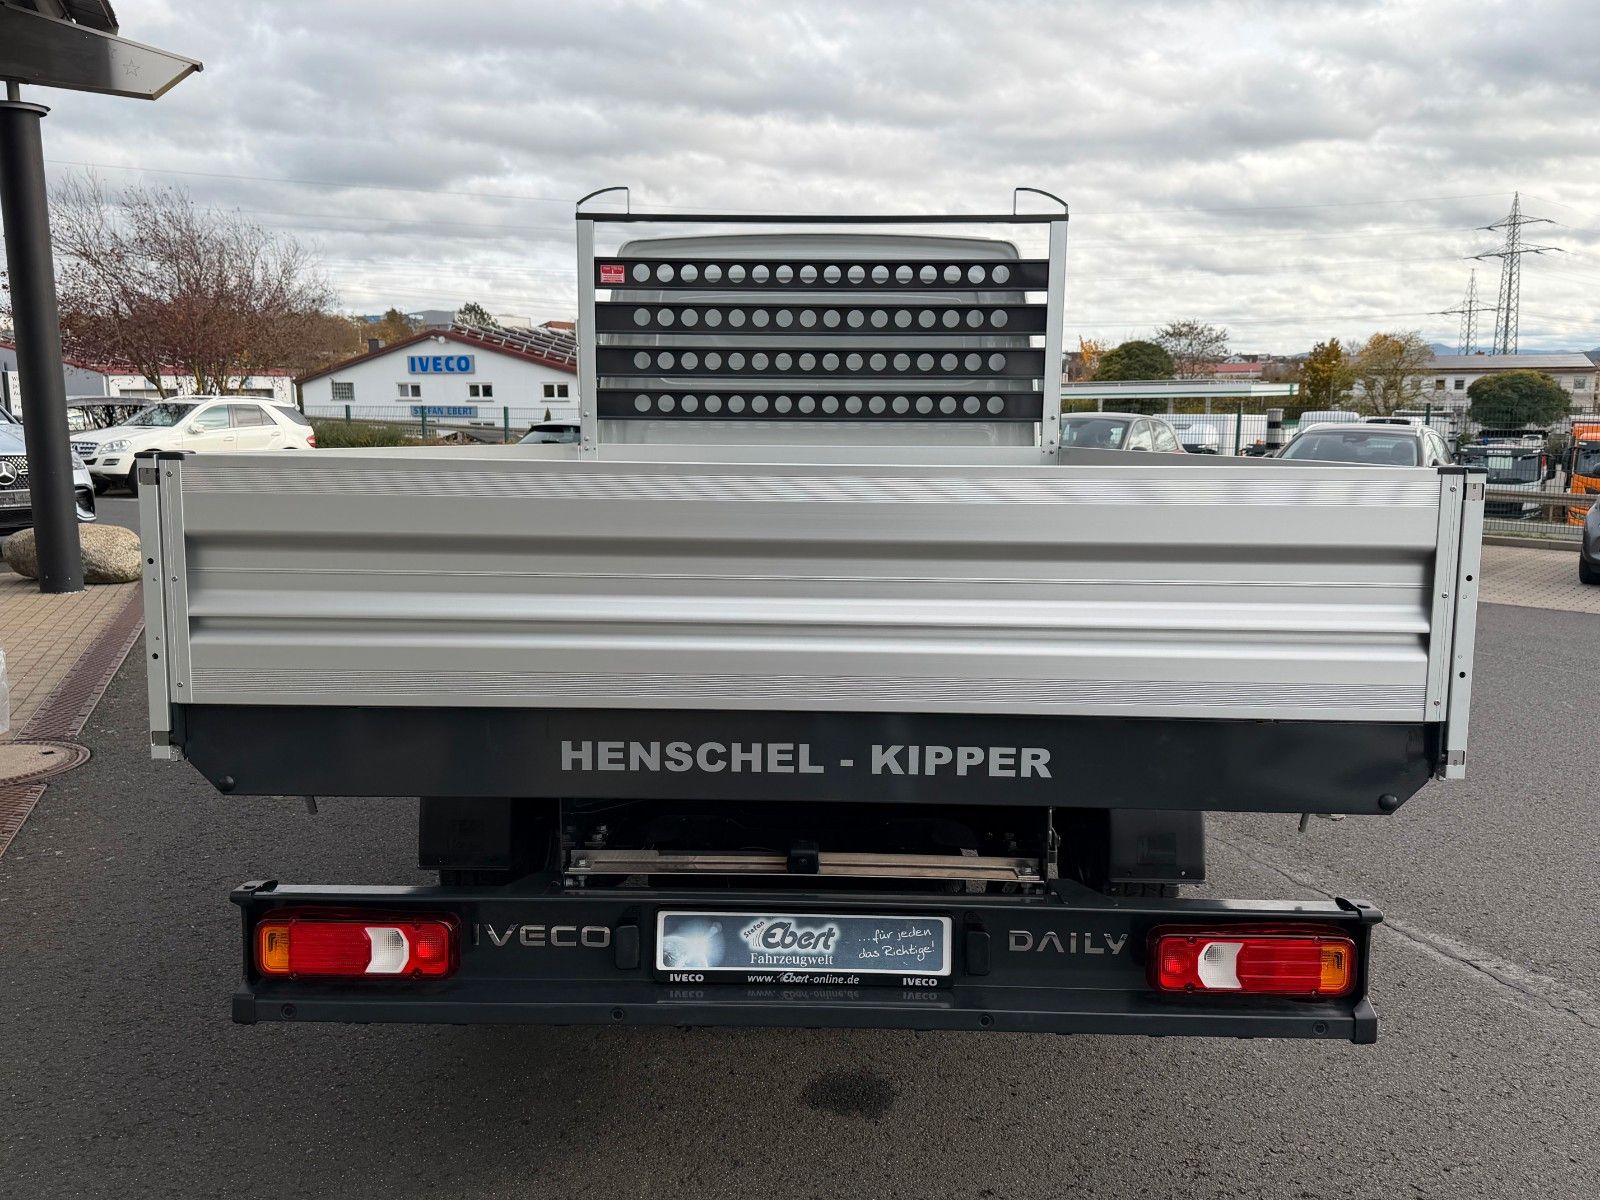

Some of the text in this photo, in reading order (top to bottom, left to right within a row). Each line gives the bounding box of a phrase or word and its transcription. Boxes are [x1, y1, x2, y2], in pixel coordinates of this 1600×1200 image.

[410, 356, 470, 372] IVECO
[561, 740, 825, 774] HENSCHEL
[871, 744, 1053, 778] KIPPER
[472, 923, 611, 947] IVECO
[743, 920, 766, 939] Stefan
[761, 921, 836, 950] Ebert
[897, 926, 932, 941] jeden
[858, 940, 935, 962] das Richtige!
[1008, 930, 1128, 955] DAILY
[750, 952, 834, 967] Fahrzeugwelt
[669, 973, 705, 982] IVECO
[902, 977, 938, 987] IVECO
